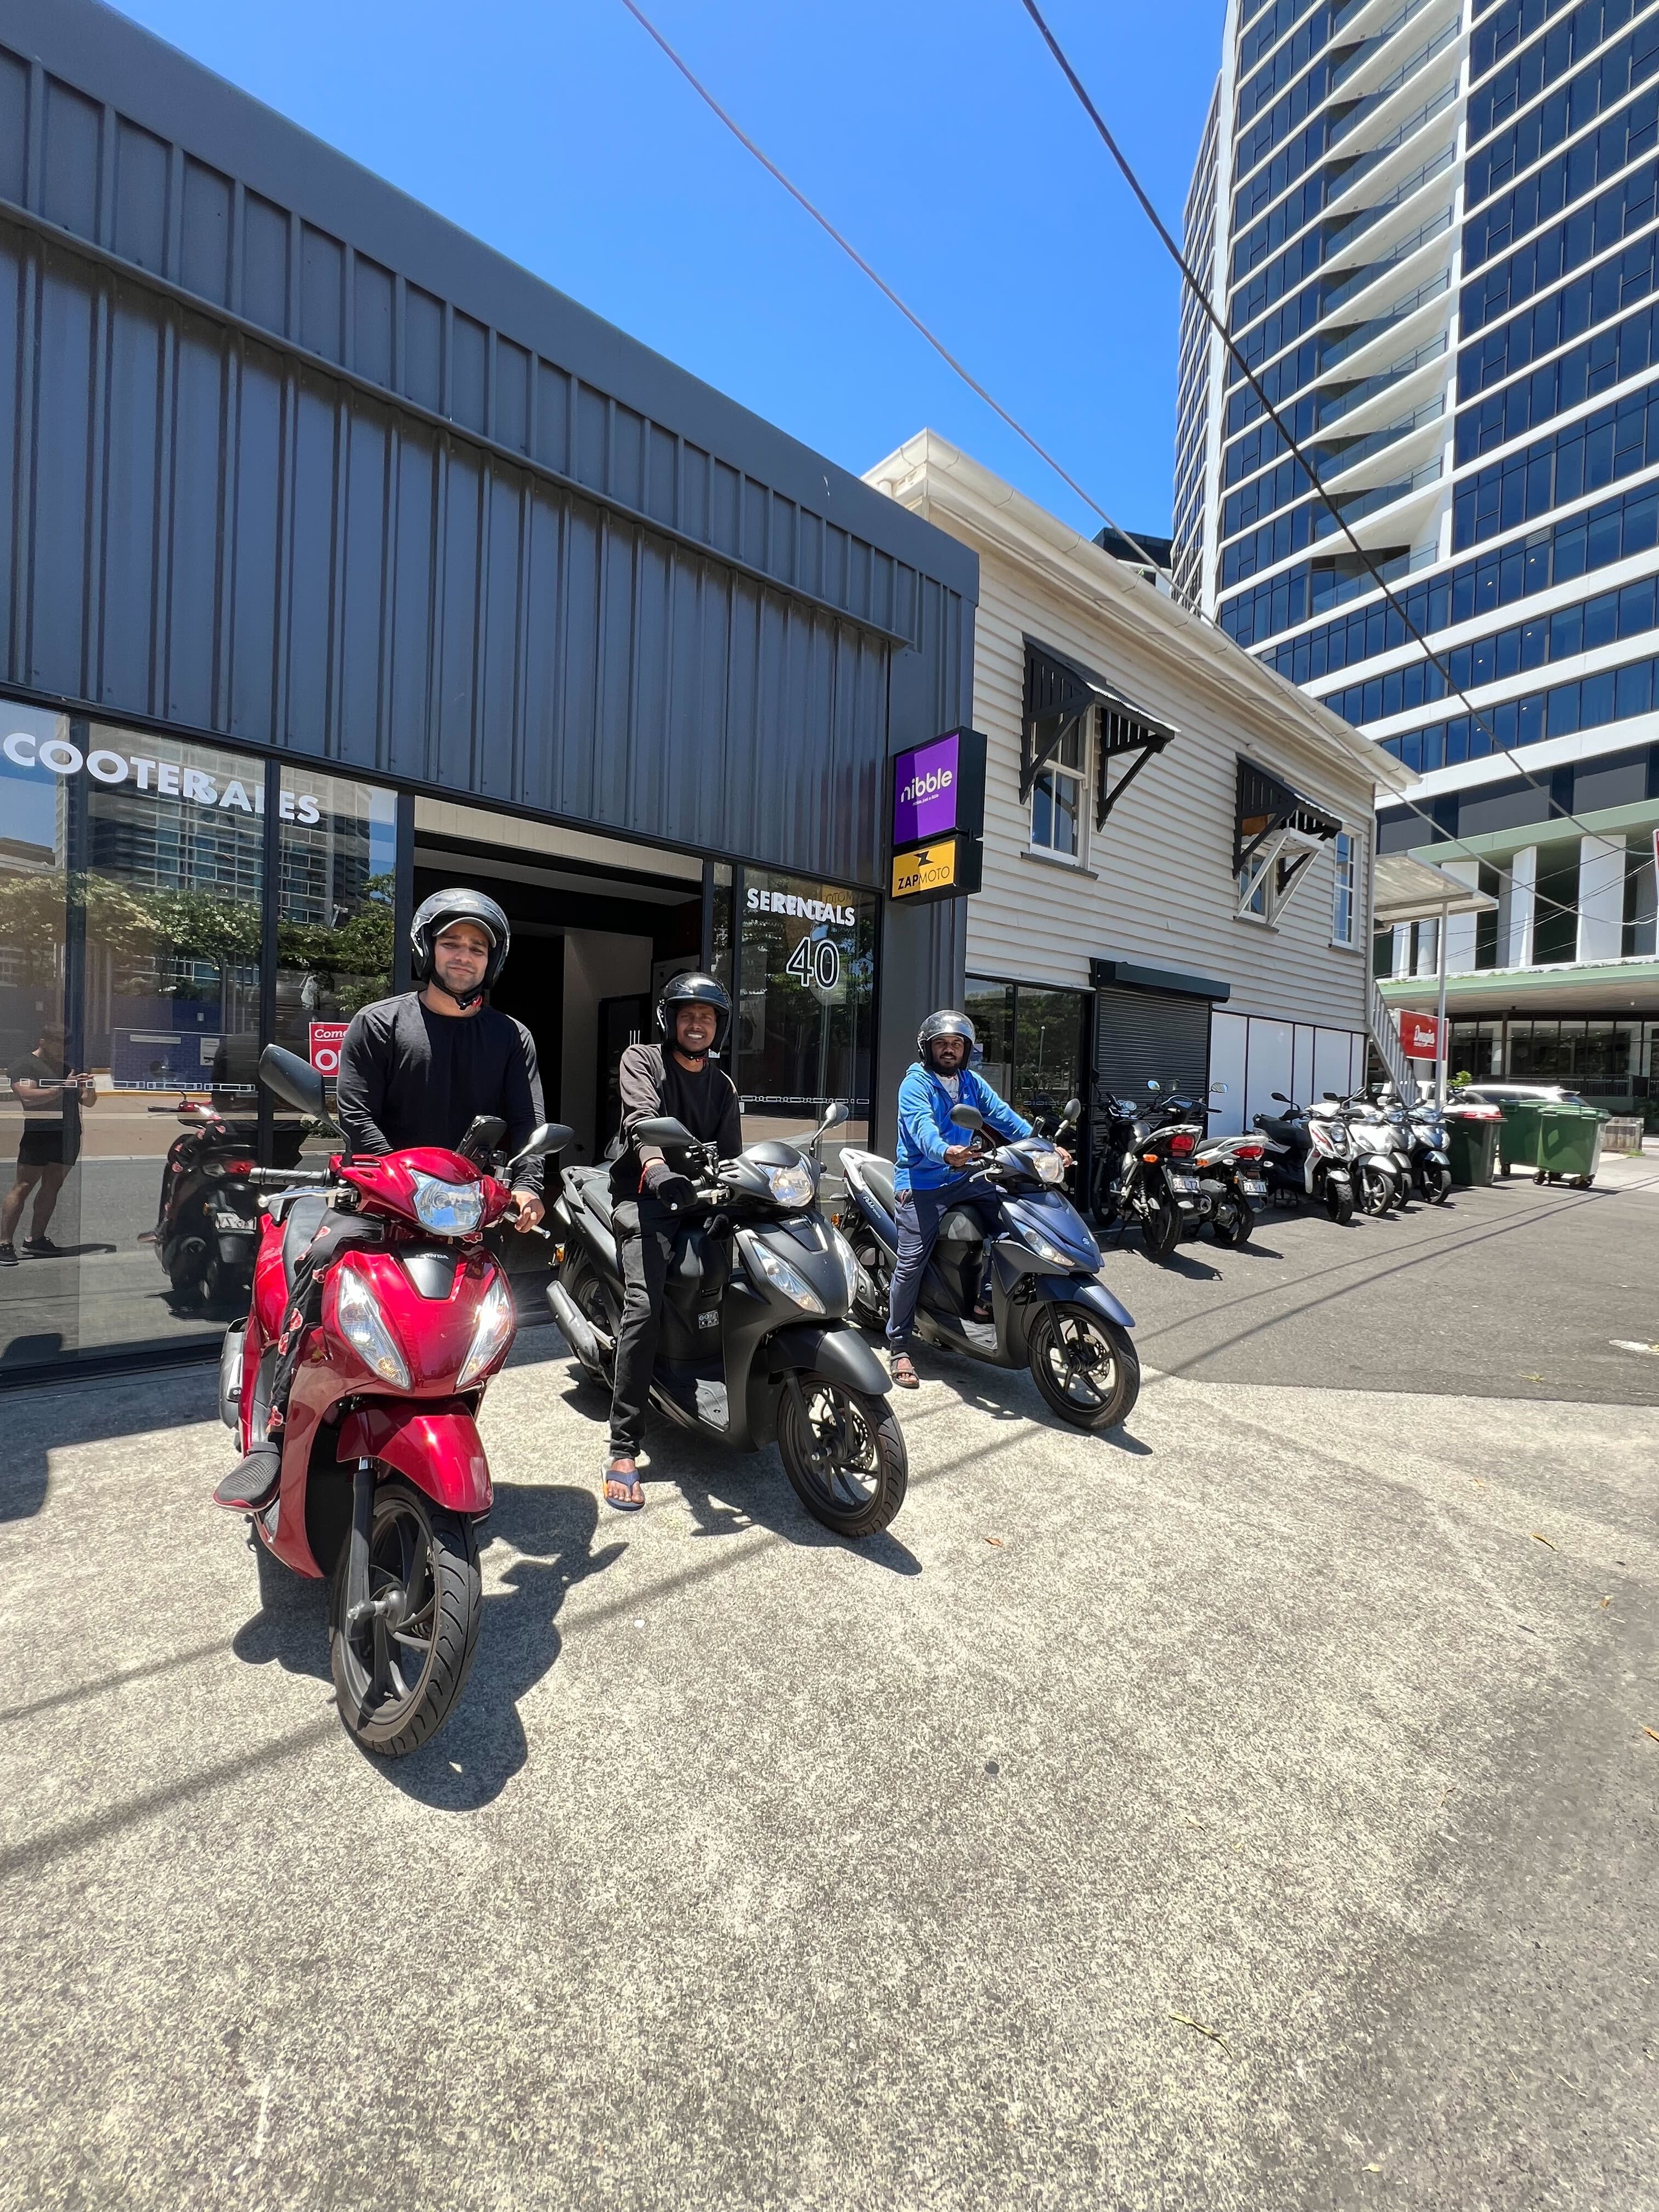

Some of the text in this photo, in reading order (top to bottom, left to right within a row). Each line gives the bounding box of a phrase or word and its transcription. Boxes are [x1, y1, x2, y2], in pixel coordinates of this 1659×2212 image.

[900, 768, 952, 803] nibble
[898, 866, 950, 890] ZAPMOTO
[786, 936, 840, 990] 40
